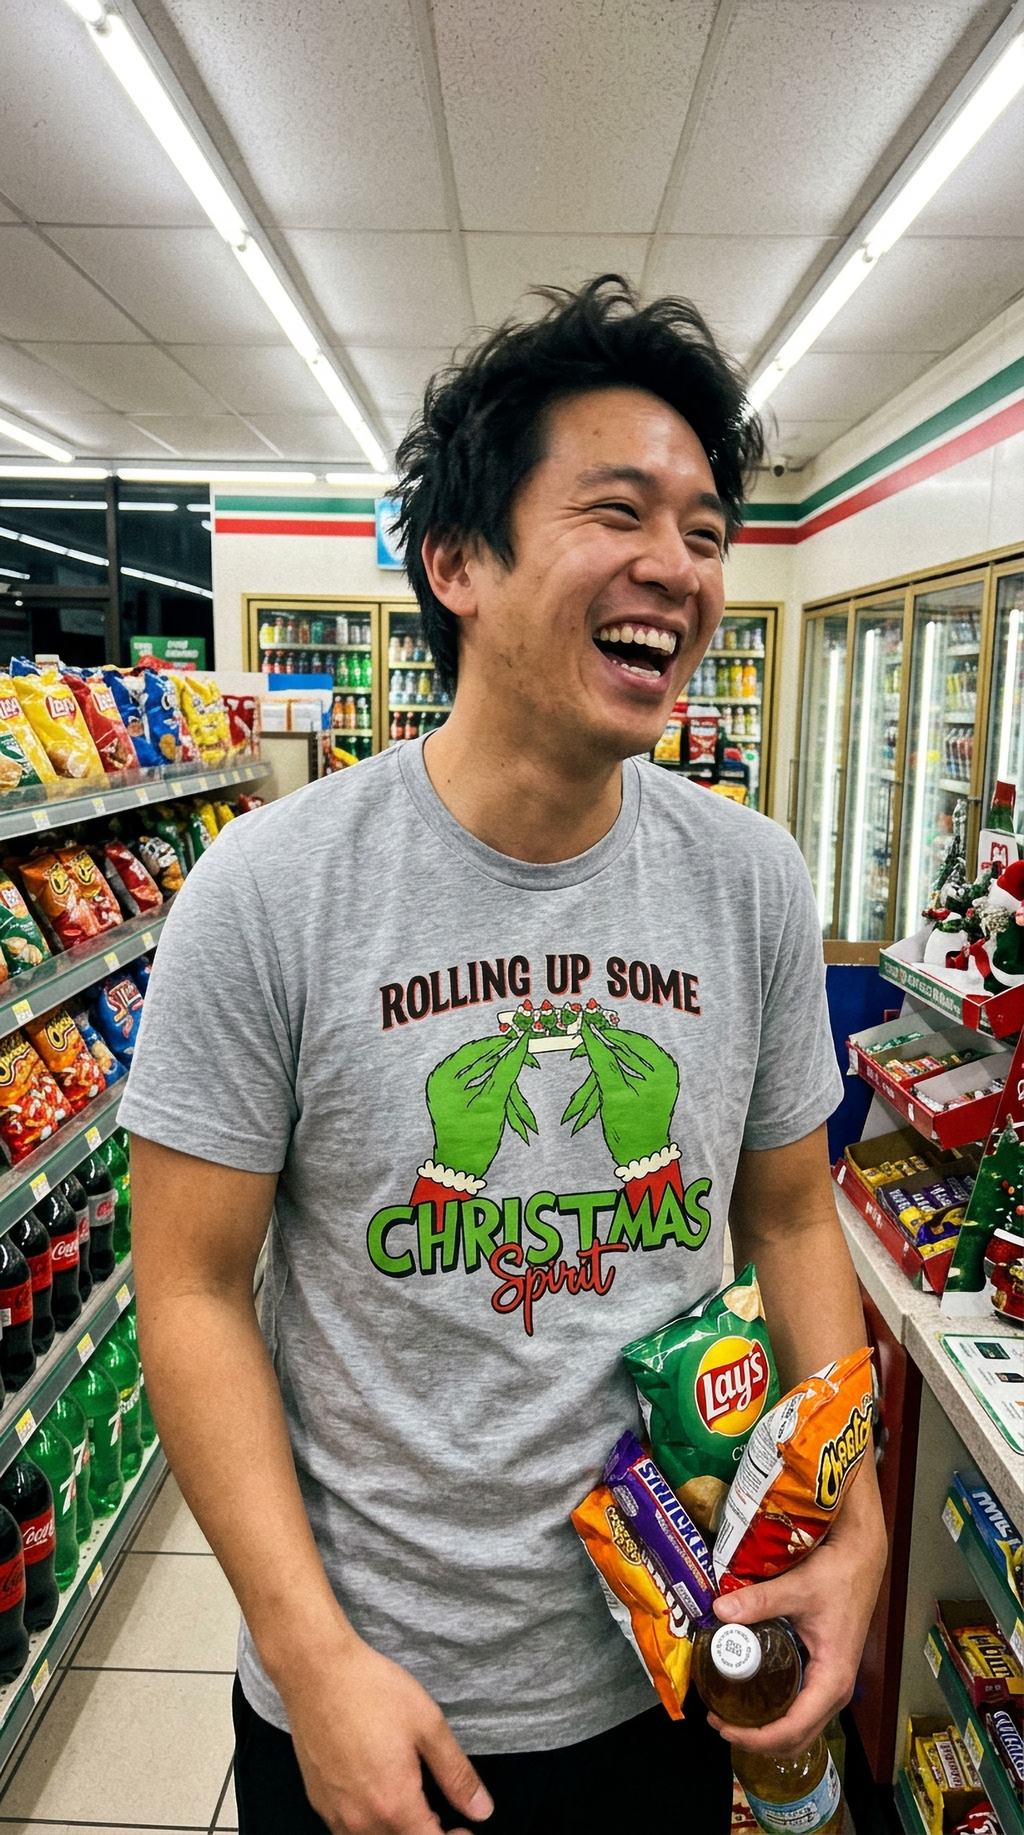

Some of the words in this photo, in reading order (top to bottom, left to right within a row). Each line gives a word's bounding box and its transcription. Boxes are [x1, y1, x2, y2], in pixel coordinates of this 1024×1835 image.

[379, 955, 531, 1032] ROLLING
[545, 953, 592, 995] UP
[606, 956, 702, 1017] SOME
[366, 1177, 713, 1279] CHRISTMAS
[489, 1237, 629, 1337] Spirit
[702, 1350, 764, 1421] Lay's
